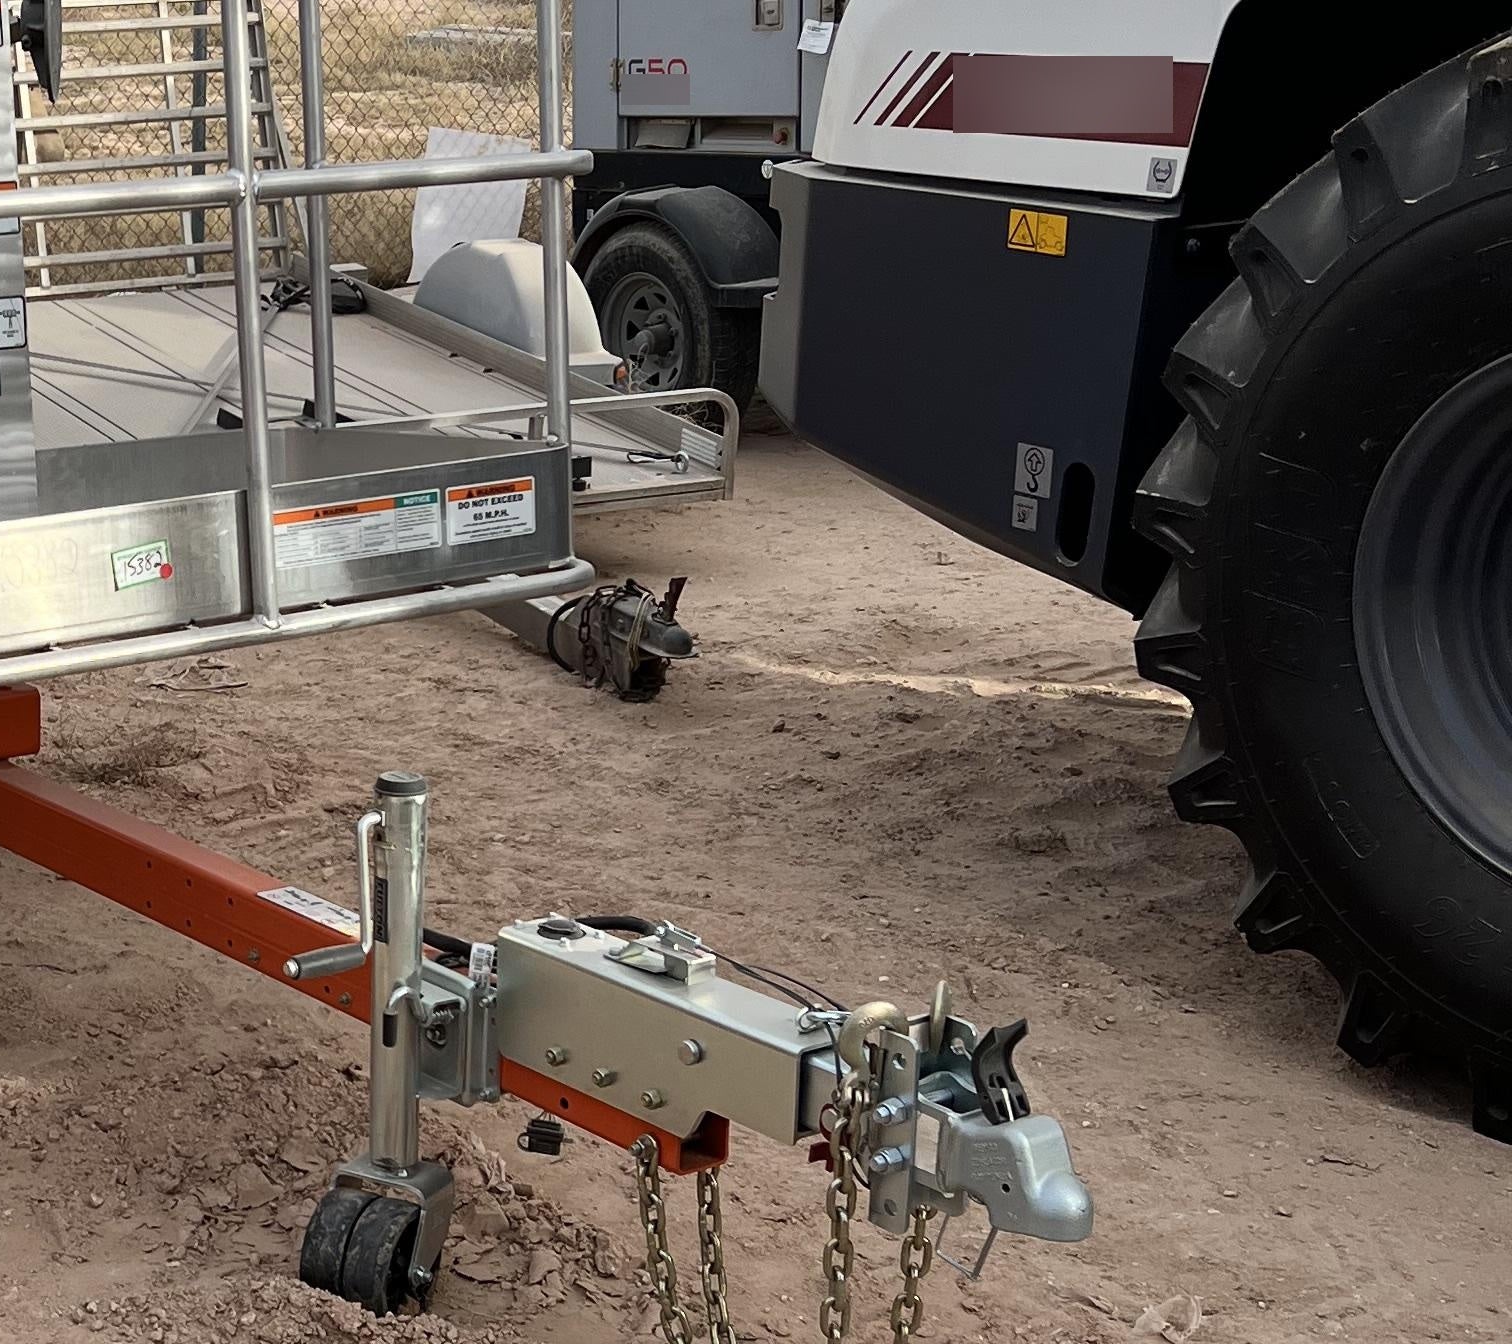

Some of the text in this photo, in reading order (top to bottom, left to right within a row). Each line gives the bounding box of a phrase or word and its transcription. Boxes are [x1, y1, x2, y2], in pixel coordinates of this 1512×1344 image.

[476, 484, 516, 496] WARNING
[403, 494, 433, 505] NOTICE
[458, 493, 524, 510] DO NOT EXCEED
[322, 505, 359, 516] WARNING
[473, 509, 510, 521] 65 M.P.H.
